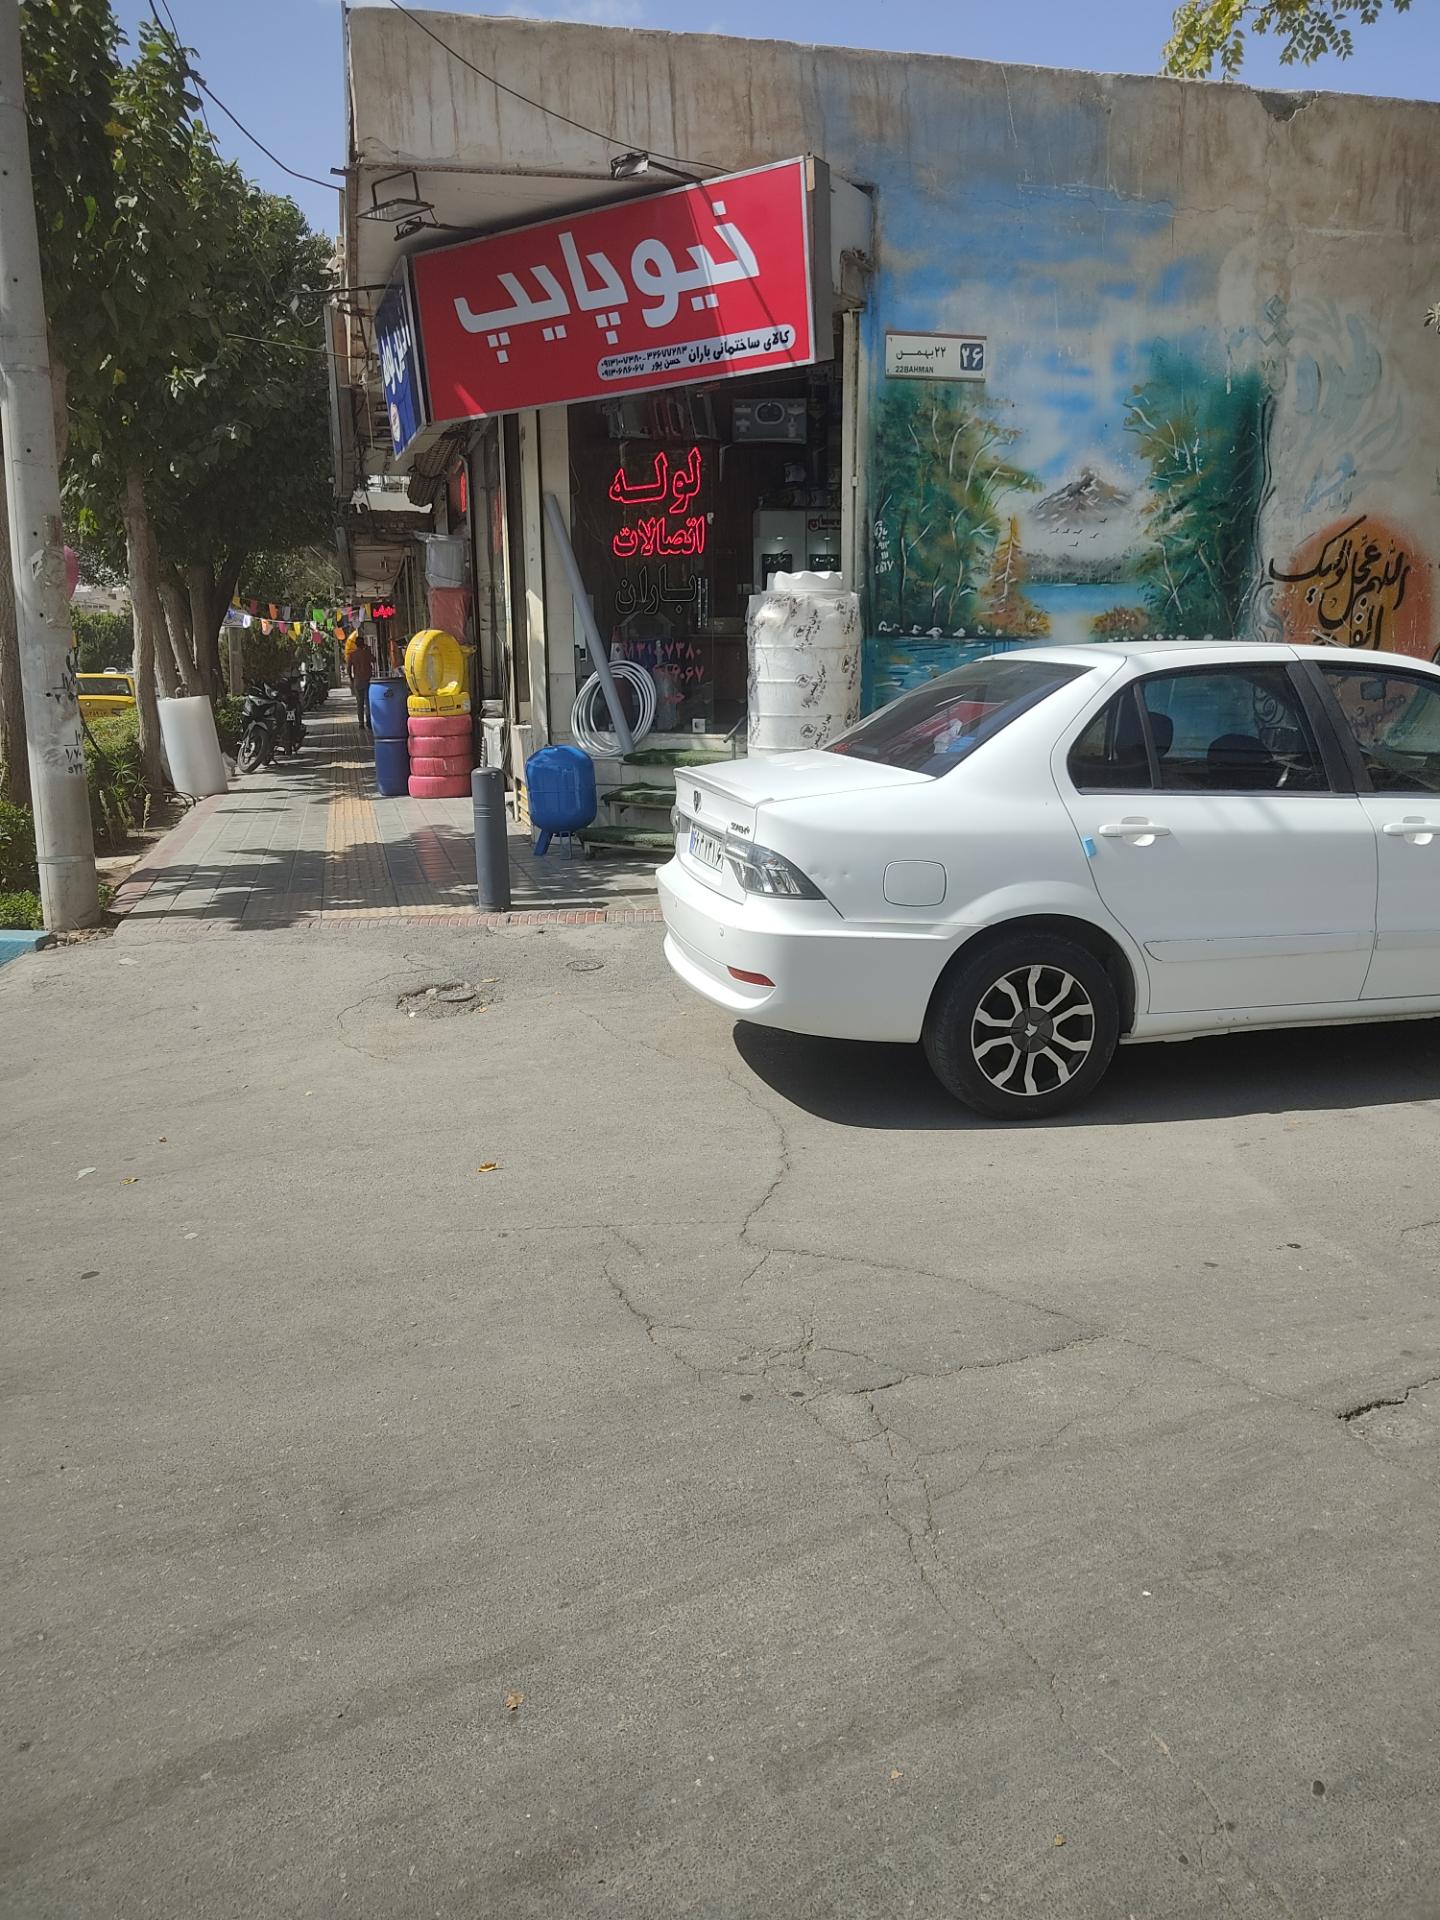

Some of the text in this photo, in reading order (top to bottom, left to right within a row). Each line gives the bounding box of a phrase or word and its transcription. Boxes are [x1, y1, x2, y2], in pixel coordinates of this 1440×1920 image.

[688, 330, 790, 363] کالای ساختمانی باران
[609, 447, 702, 515] لوله
[612, 515, 706, 557] اتصالات
[615, 563, 697, 614] باران
